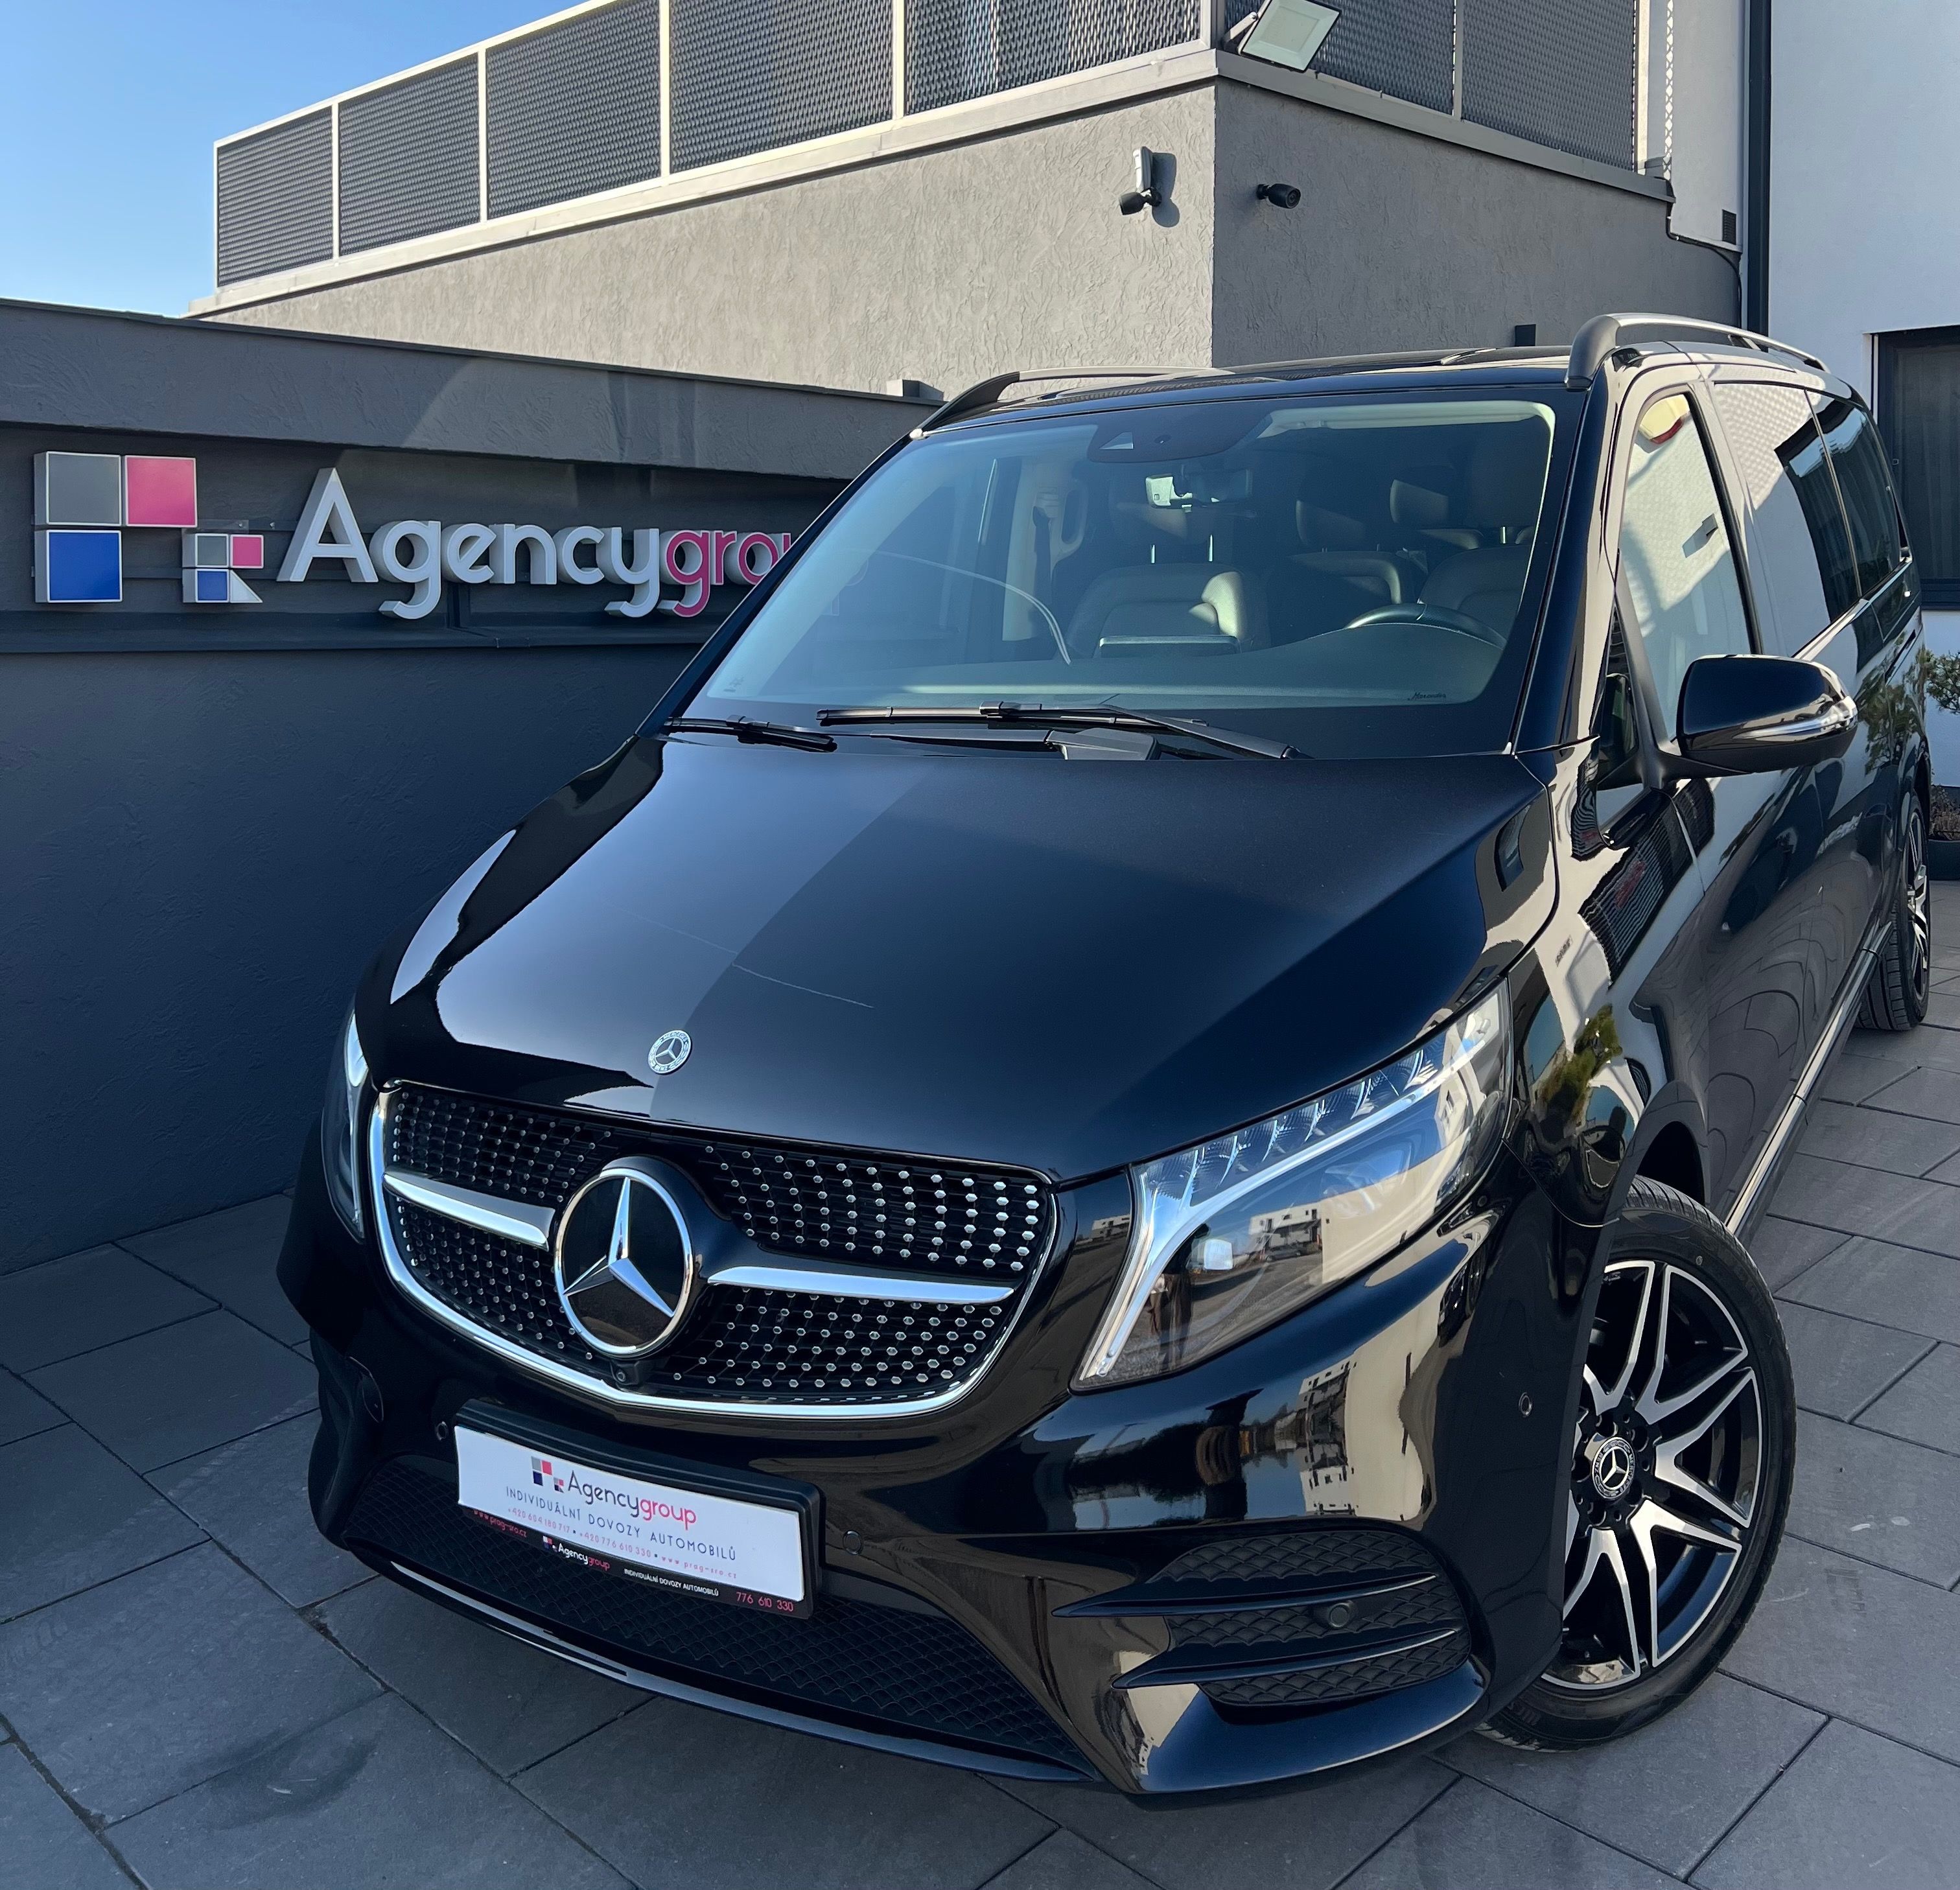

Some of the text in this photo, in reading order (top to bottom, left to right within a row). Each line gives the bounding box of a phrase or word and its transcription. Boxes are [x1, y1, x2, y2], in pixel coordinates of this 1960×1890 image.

[275, 467, 791, 620] Agencygro
[568, 1470, 697, 1530] Agencygroup
[506, 1486, 736, 1561] INDIVIDUÁLNÍ DOVOZY AUTOMOBILŮ
[559, 1543, 611, 1571] Agencygroup
[601, 1537, 616, 1548] 776
[619, 1543, 633, 1553] 610
[635, 1546, 651, 1557] 330
[659, 1577, 682, 1588] DOVOZY
[736, 1592, 794, 1612] 776 610 330
